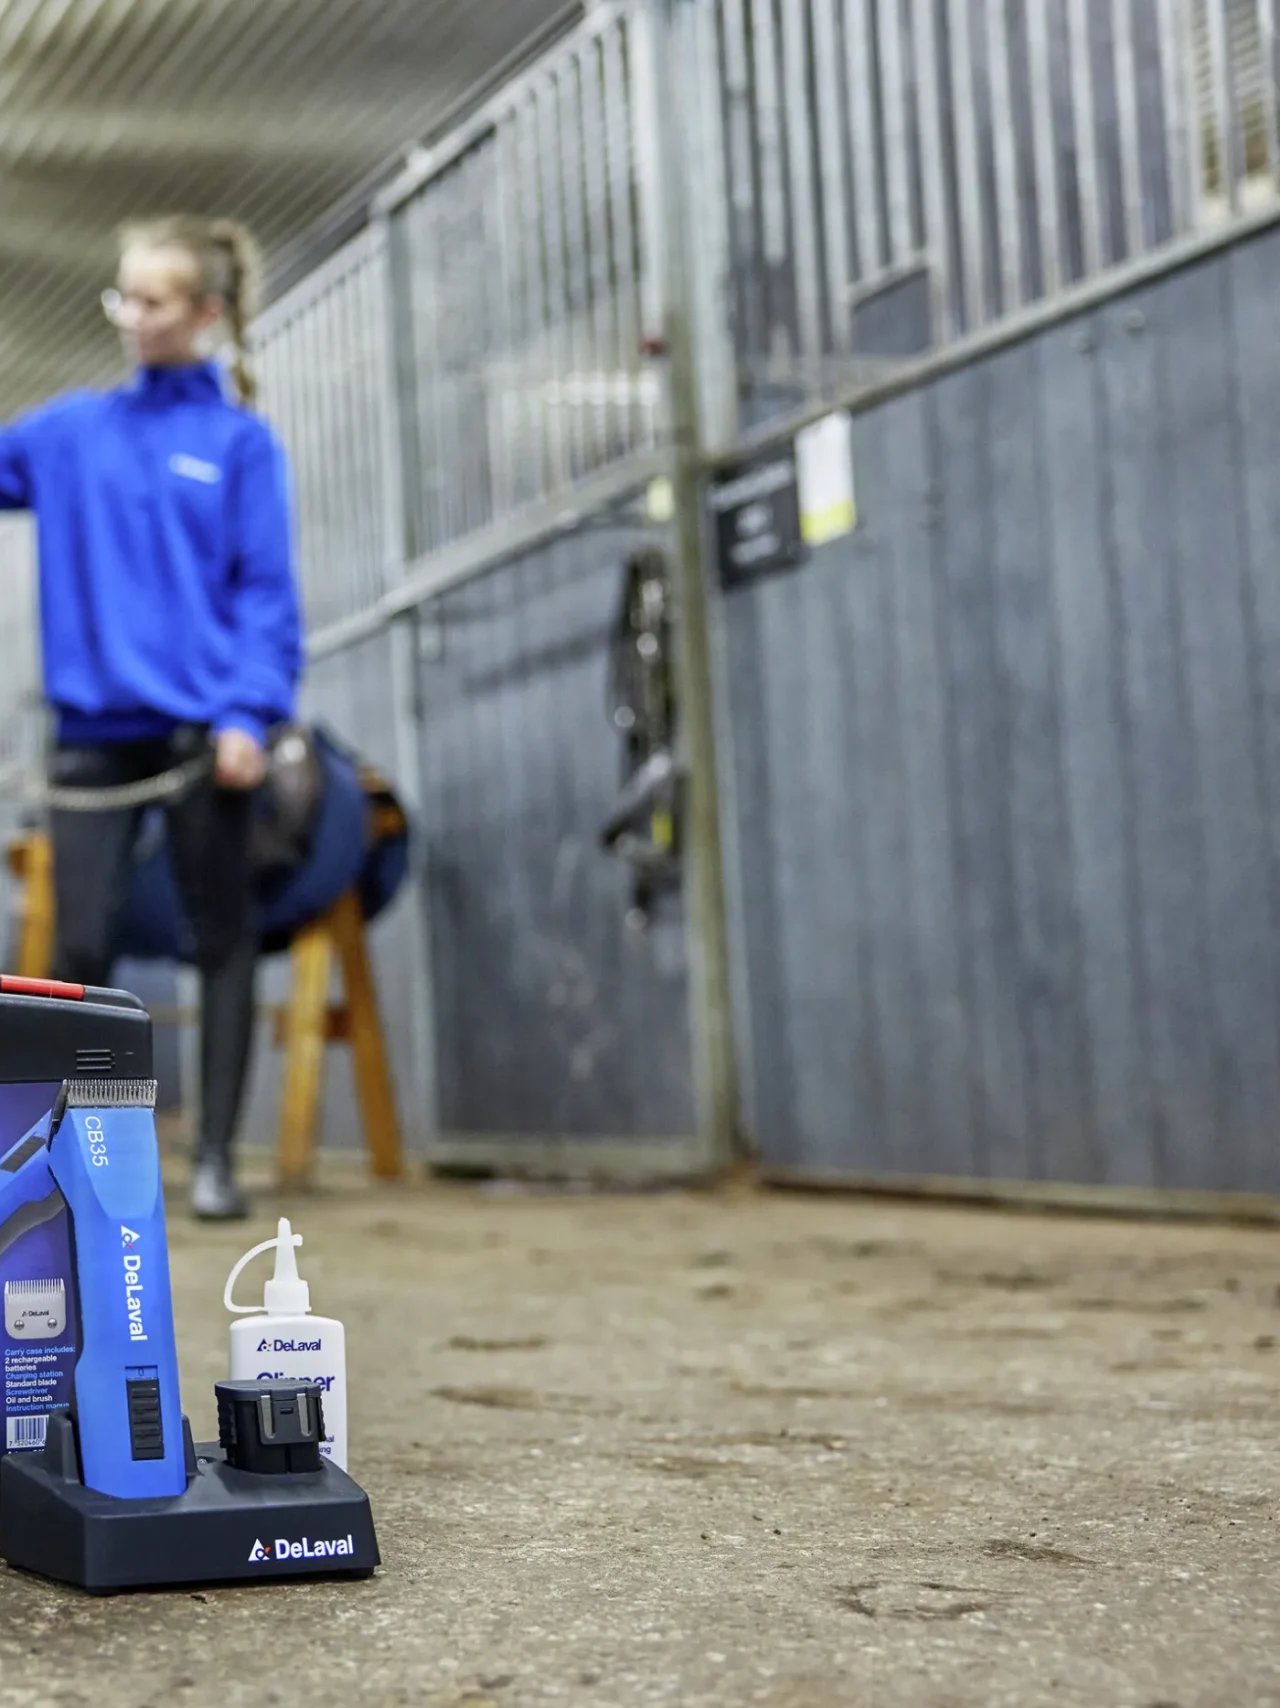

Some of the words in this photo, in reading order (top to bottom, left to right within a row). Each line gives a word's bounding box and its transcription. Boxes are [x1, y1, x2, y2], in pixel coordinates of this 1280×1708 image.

[85, 1115, 108, 1167] CB35
[123, 1255, 148, 1341] DeLaval
[28, 1309, 50, 1317] DeLaval
[273, 1338, 321, 1351] DeLaval
[11, 1355, 57, 1364] rechargeable
[5, 1364, 37, 1372] batteries
[5, 1372, 38, 1380] Charging
[5, 1380, 37, 1388] Standard
[6, 1388, 48, 1396] Screwdriver
[6, 1396, 16, 1404] Oil
[6, 1403, 44, 1412] Instruction
[274, 1534, 354, 1559] DeLaval
